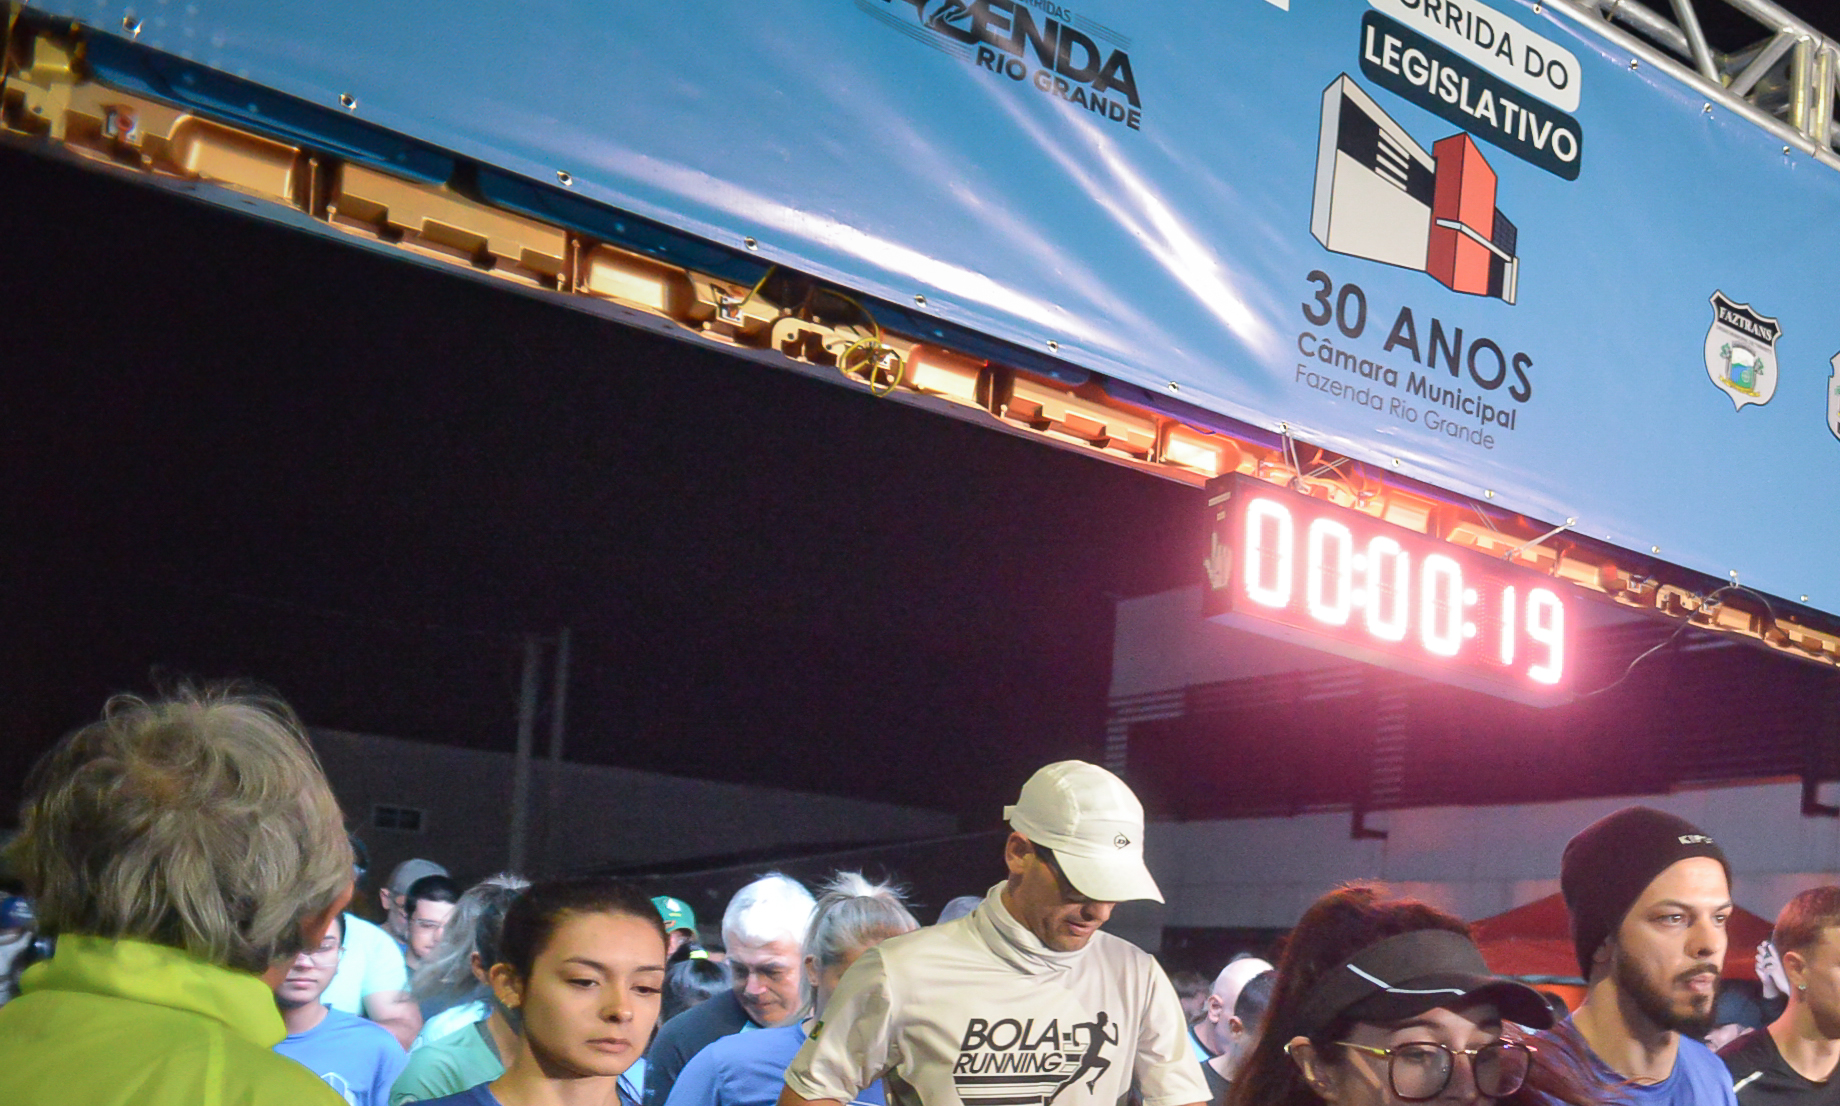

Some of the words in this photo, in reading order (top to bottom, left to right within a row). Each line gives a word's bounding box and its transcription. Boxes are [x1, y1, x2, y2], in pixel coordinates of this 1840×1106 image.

[976, 45, 1027, 81] RIO
[1033, 69, 1142, 131] GRANDE
[1364, 25, 1578, 162] LEGISLATIVO
[1524, 46, 1568, 90] DO
[1302, 269, 1367, 339] 30
[1383, 306, 1533, 403] ANOS
[1719, 306, 1773, 342] FAZTRANS
[1295, 363, 1383, 411] Fazenda
[1389, 397, 1418, 423] Rio
[1424, 410, 1495, 450] Grande
[1297, 331, 1399, 387] Câmara
[1405, 371, 1517, 431] Municipal
[1244, 497, 1565, 685] 00:00:19
[953, 1053, 1063, 1074] RUNNING
[961, 1019, 1060, 1051] BOLA
